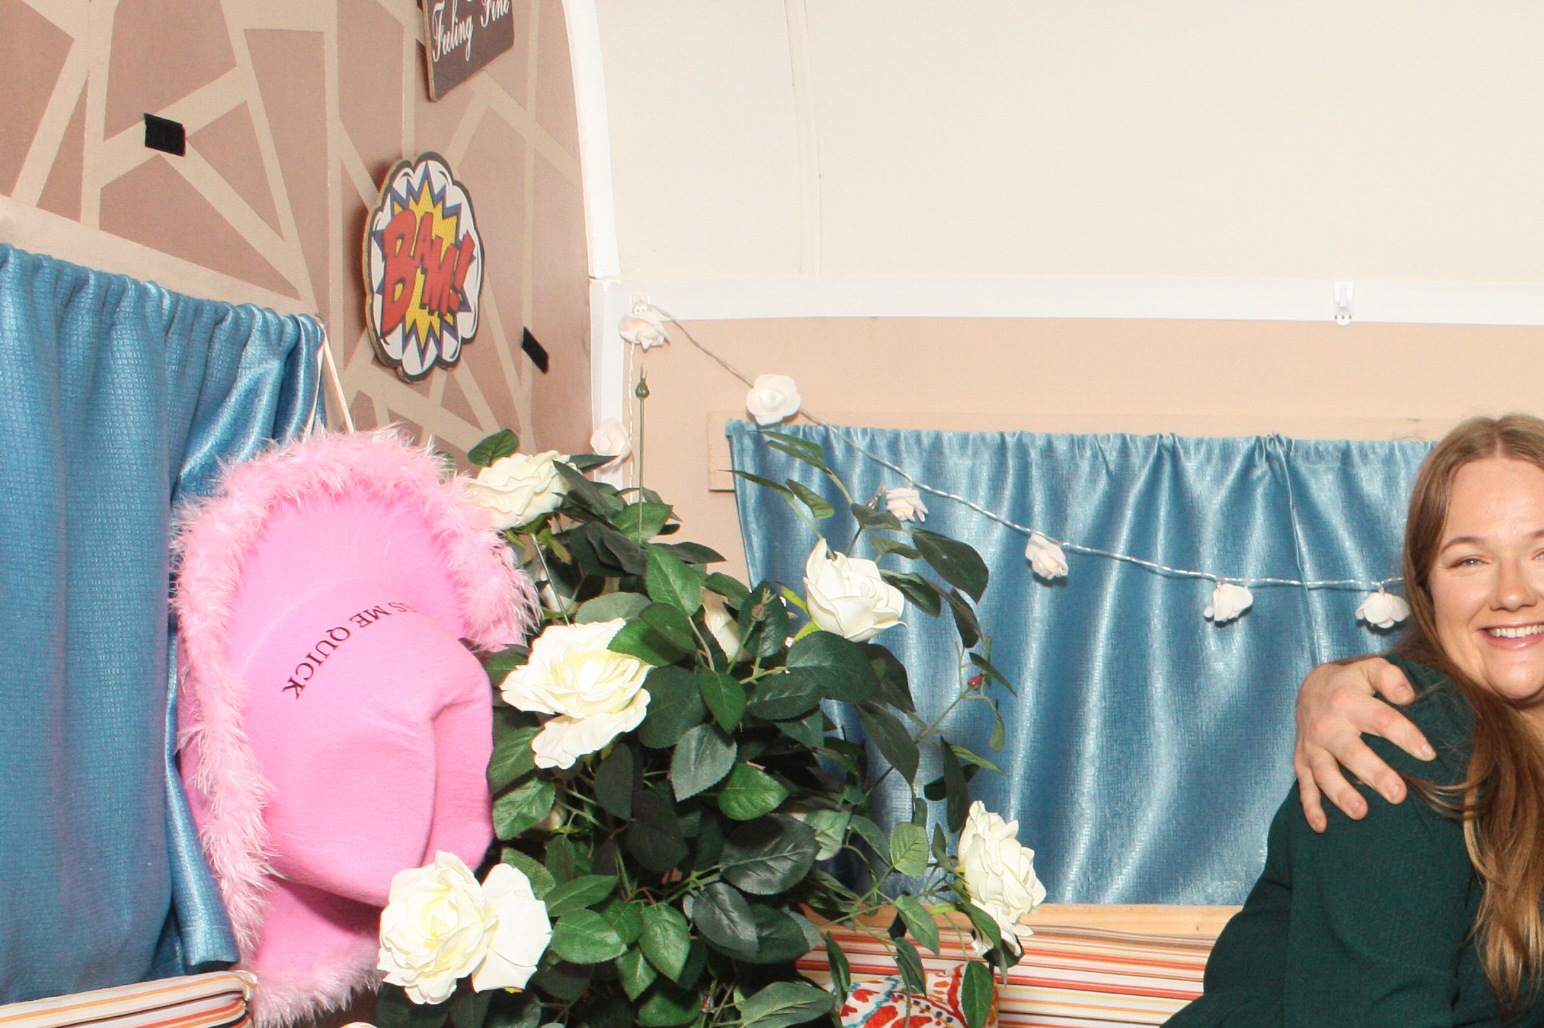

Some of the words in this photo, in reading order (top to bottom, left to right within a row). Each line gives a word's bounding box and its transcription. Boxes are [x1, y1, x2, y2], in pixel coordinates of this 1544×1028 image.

[432, 0, 474, 62] Feeling
[380, 208, 476, 334] BAM!
[348, 605, 392, 629] ME
[281, 626, 351, 700] QUICK
